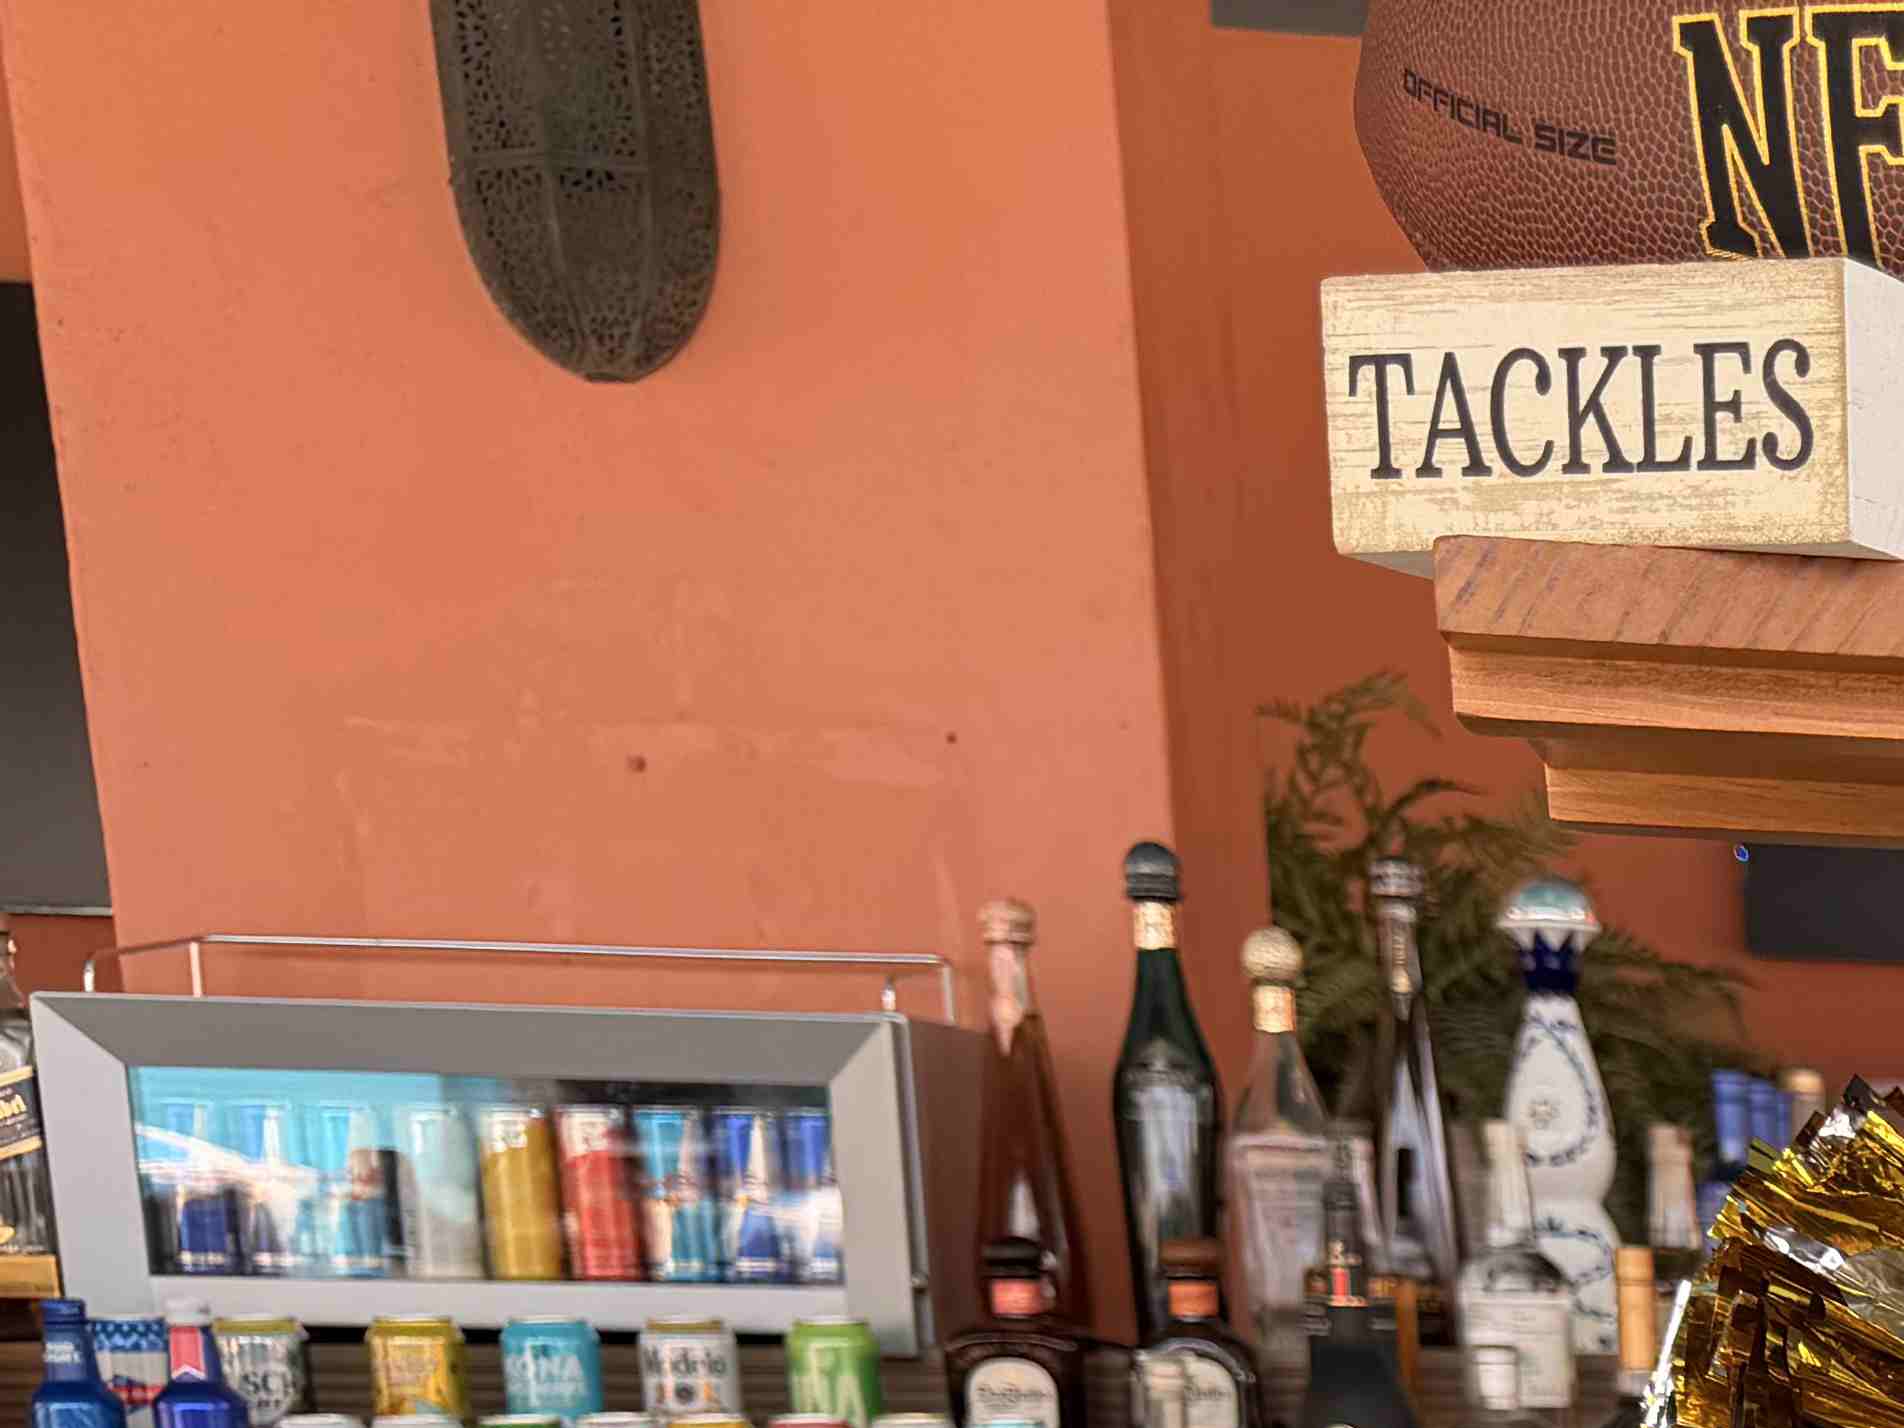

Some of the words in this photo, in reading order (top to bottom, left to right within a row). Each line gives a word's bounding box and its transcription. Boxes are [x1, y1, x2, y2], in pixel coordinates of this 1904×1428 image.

[1402, 67, 1523, 148] OFFICIAL
[1533, 129, 1618, 167] SIZE
[1347, 337, 1815, 480] TACKLES
